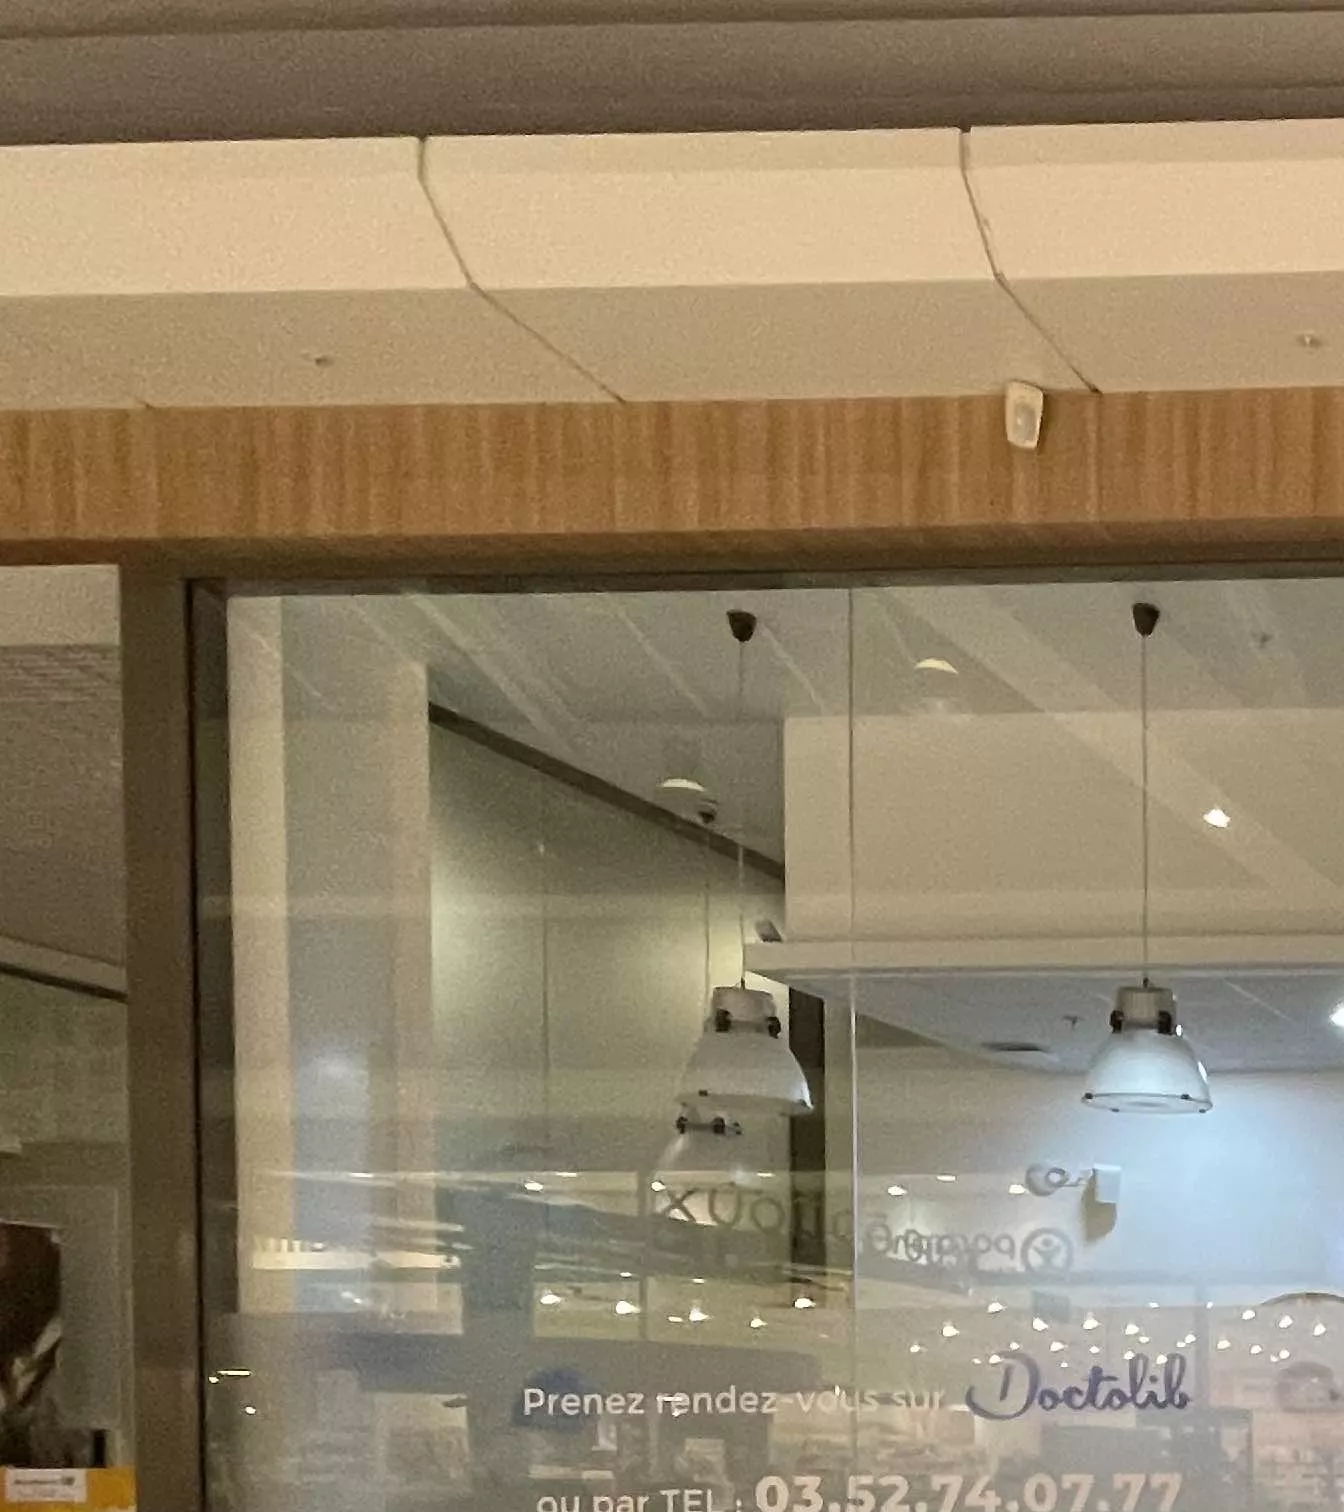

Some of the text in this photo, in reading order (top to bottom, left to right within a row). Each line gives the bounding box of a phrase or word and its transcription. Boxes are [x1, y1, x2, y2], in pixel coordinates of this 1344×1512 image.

[523, 1350, 1193, 1421] Prenez rendez-vous sur Doctolib
